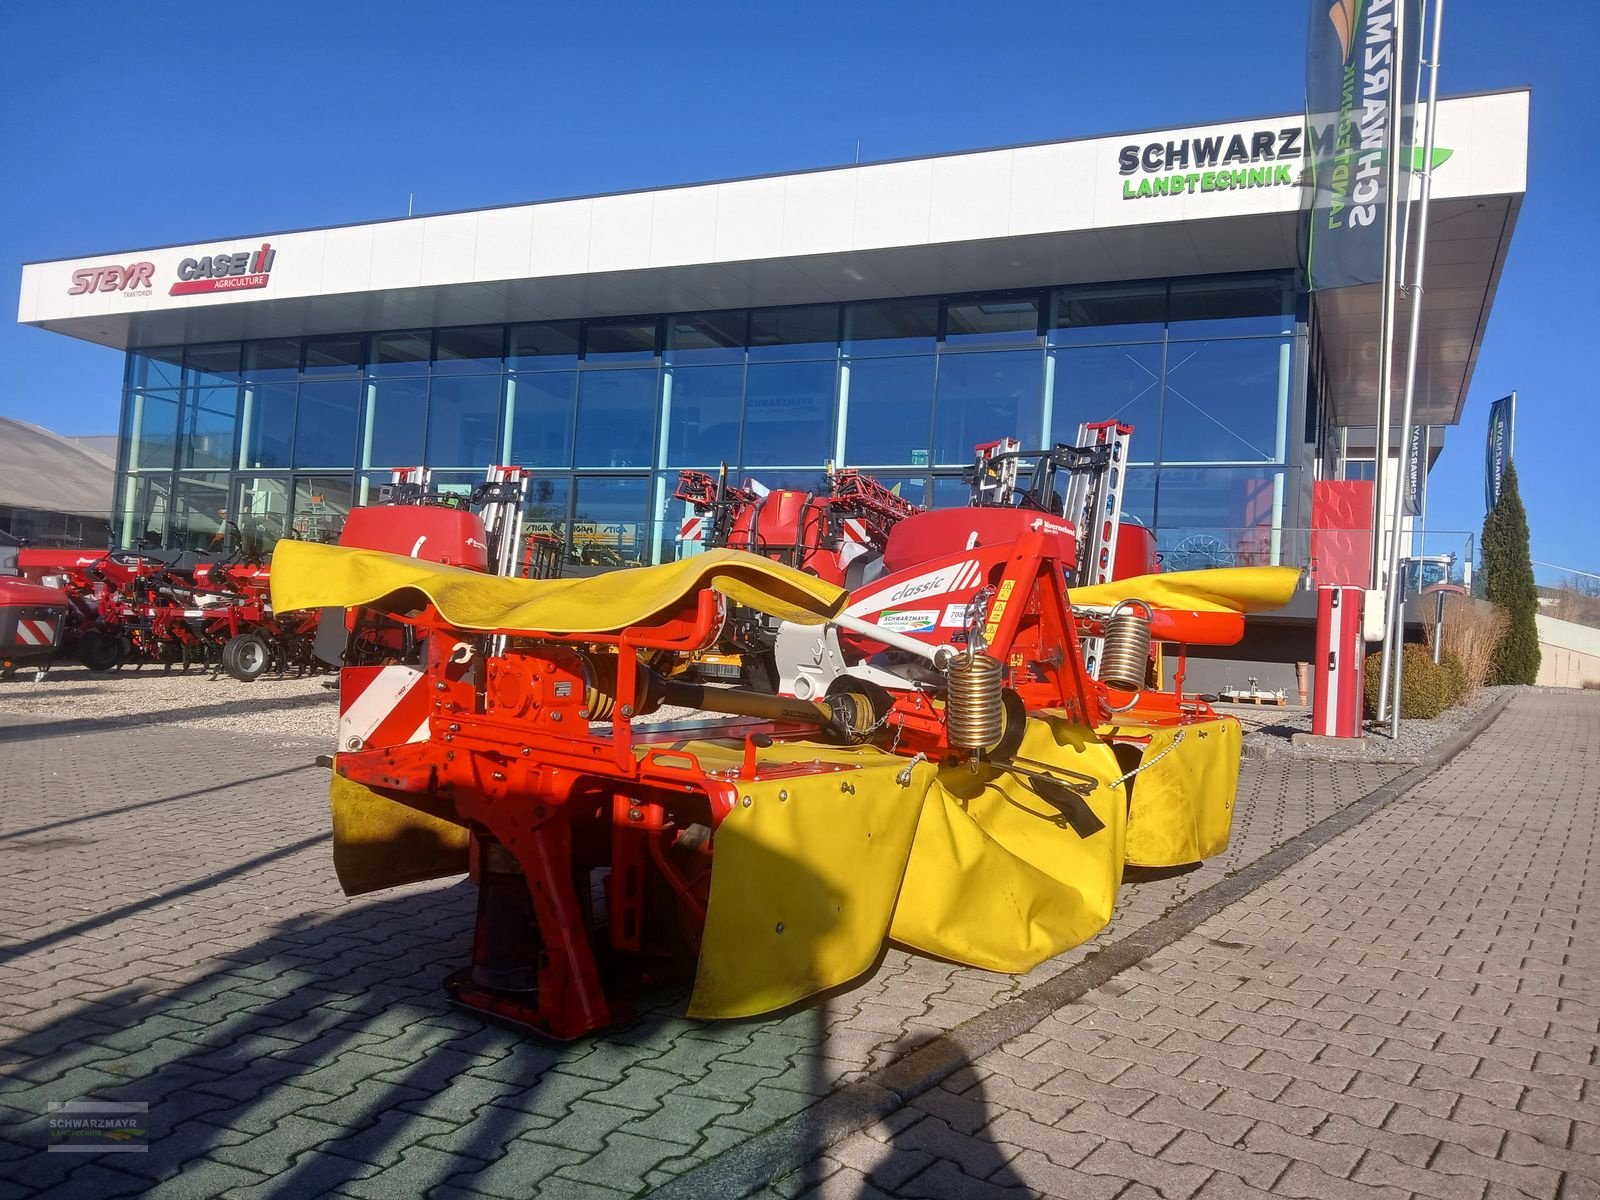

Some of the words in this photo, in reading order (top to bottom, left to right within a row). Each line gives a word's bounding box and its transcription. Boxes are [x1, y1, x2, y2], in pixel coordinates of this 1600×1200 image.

[1123, 164, 1292, 200] LANDTECHNIK
[177, 251, 250, 281] CASE
[67, 261, 155, 296] STEYR
[214, 276, 264, 289] AGRICULTURE
[123, 289, 153, 298] TRAKTOREN
[526, 524, 549, 532] STIGA
[603, 526, 628, 534] STIGA
[891, 576, 945, 602] classic
